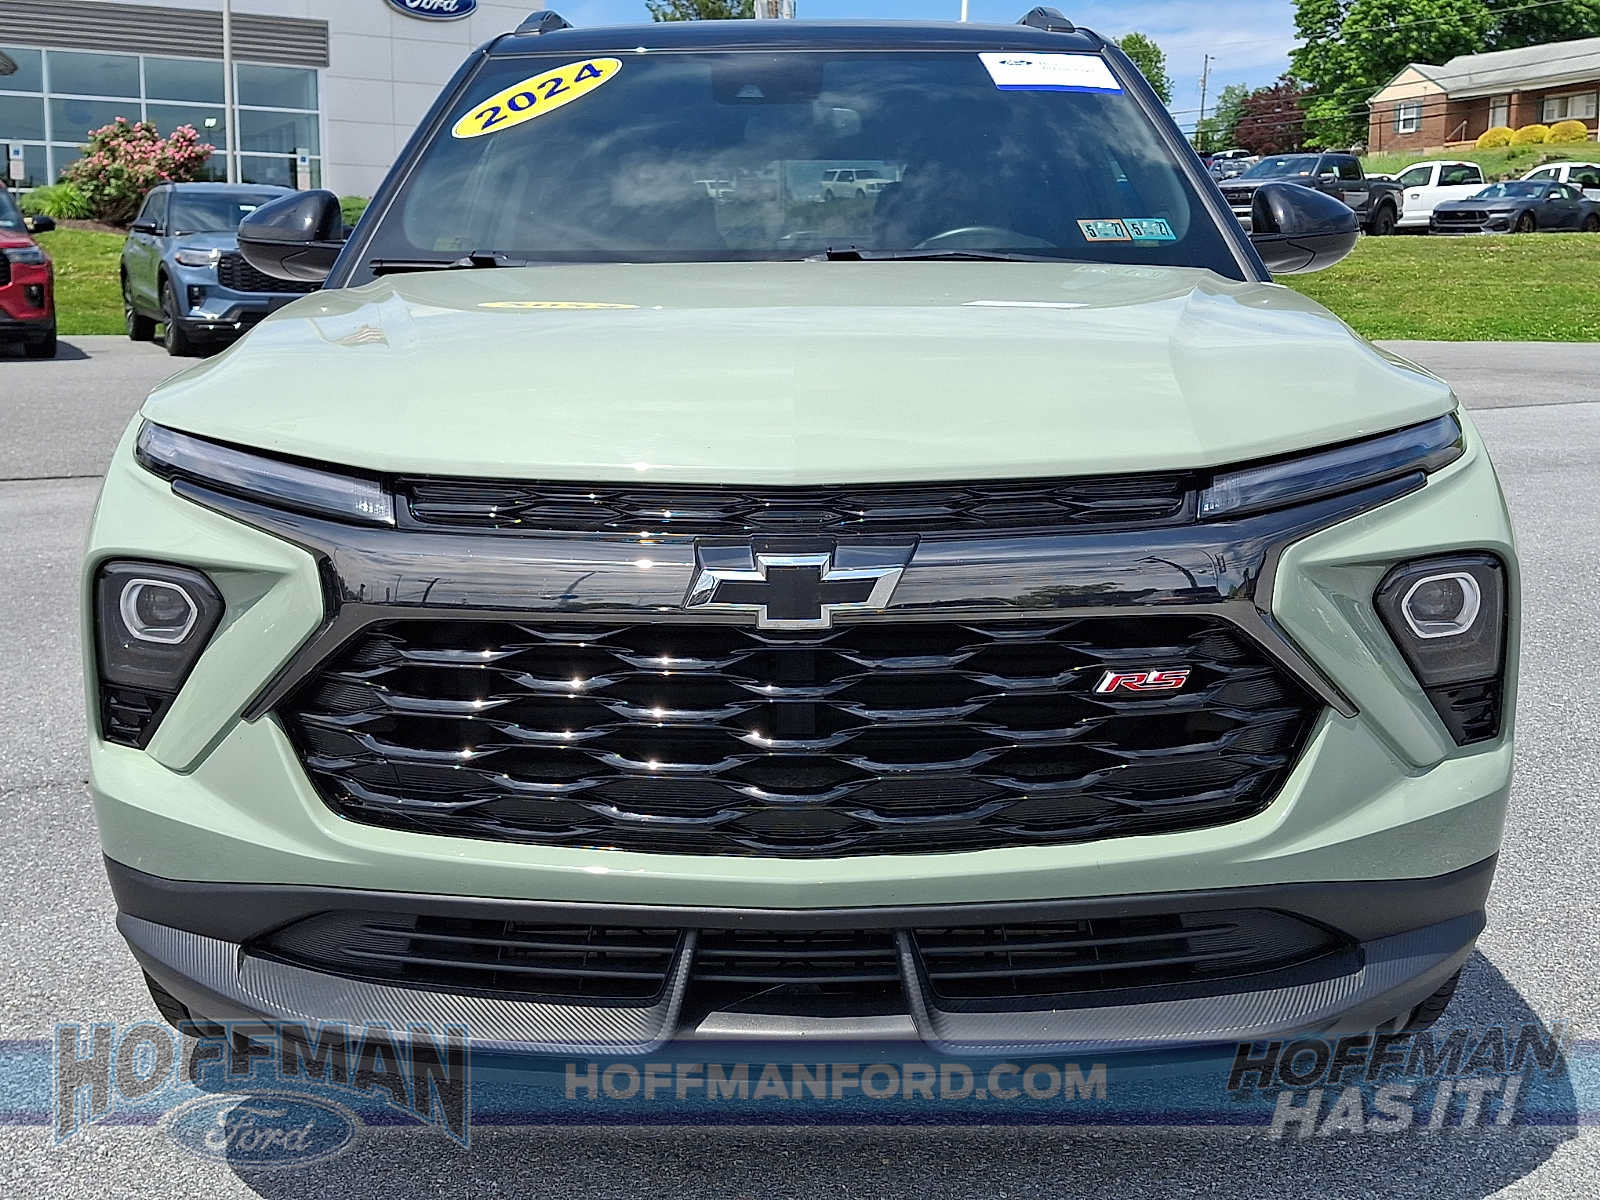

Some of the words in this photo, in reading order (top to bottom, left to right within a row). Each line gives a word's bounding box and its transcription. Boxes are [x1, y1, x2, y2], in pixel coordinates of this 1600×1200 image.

[475, 63, 604, 130] 2024
[1086, 224, 1097, 238] 5
[1131, 223, 1143, 236] 5
[1096, 670, 1191, 693] RS
